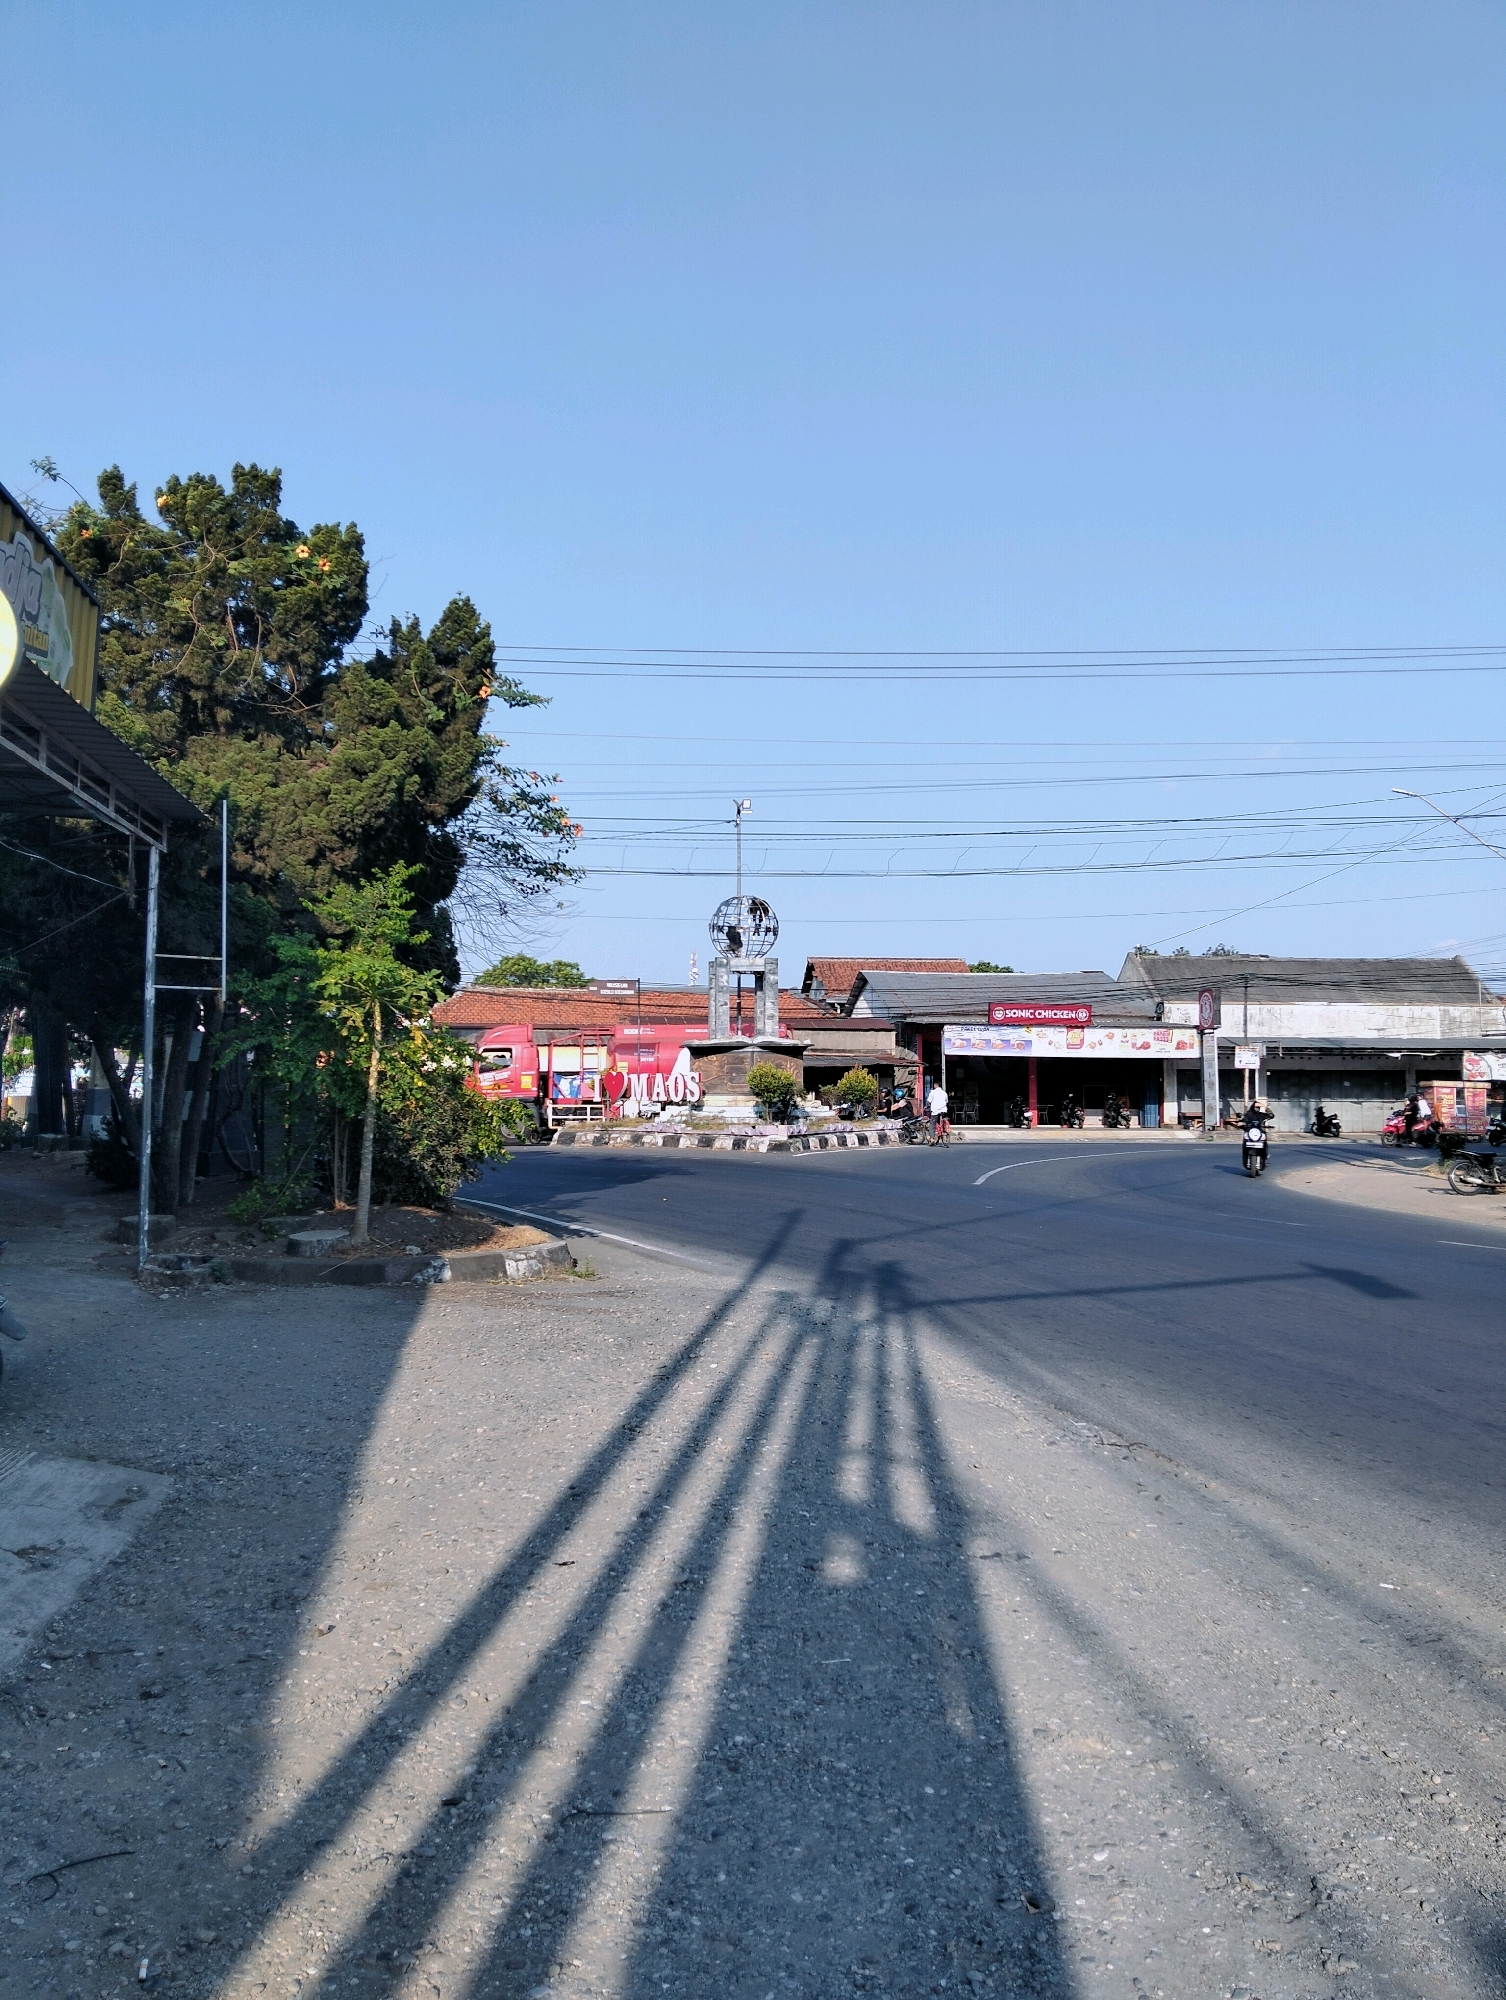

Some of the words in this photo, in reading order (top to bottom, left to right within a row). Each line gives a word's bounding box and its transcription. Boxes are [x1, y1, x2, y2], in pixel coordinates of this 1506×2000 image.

[21, 621, 48, 652] ultan
[1006, 1009, 1034, 1018] SONIC
[1035, 1010, 1076, 1019] CHICKEN
[593, 1075, 602, 1102] I
[629, 1072, 701, 1102] MAOS
